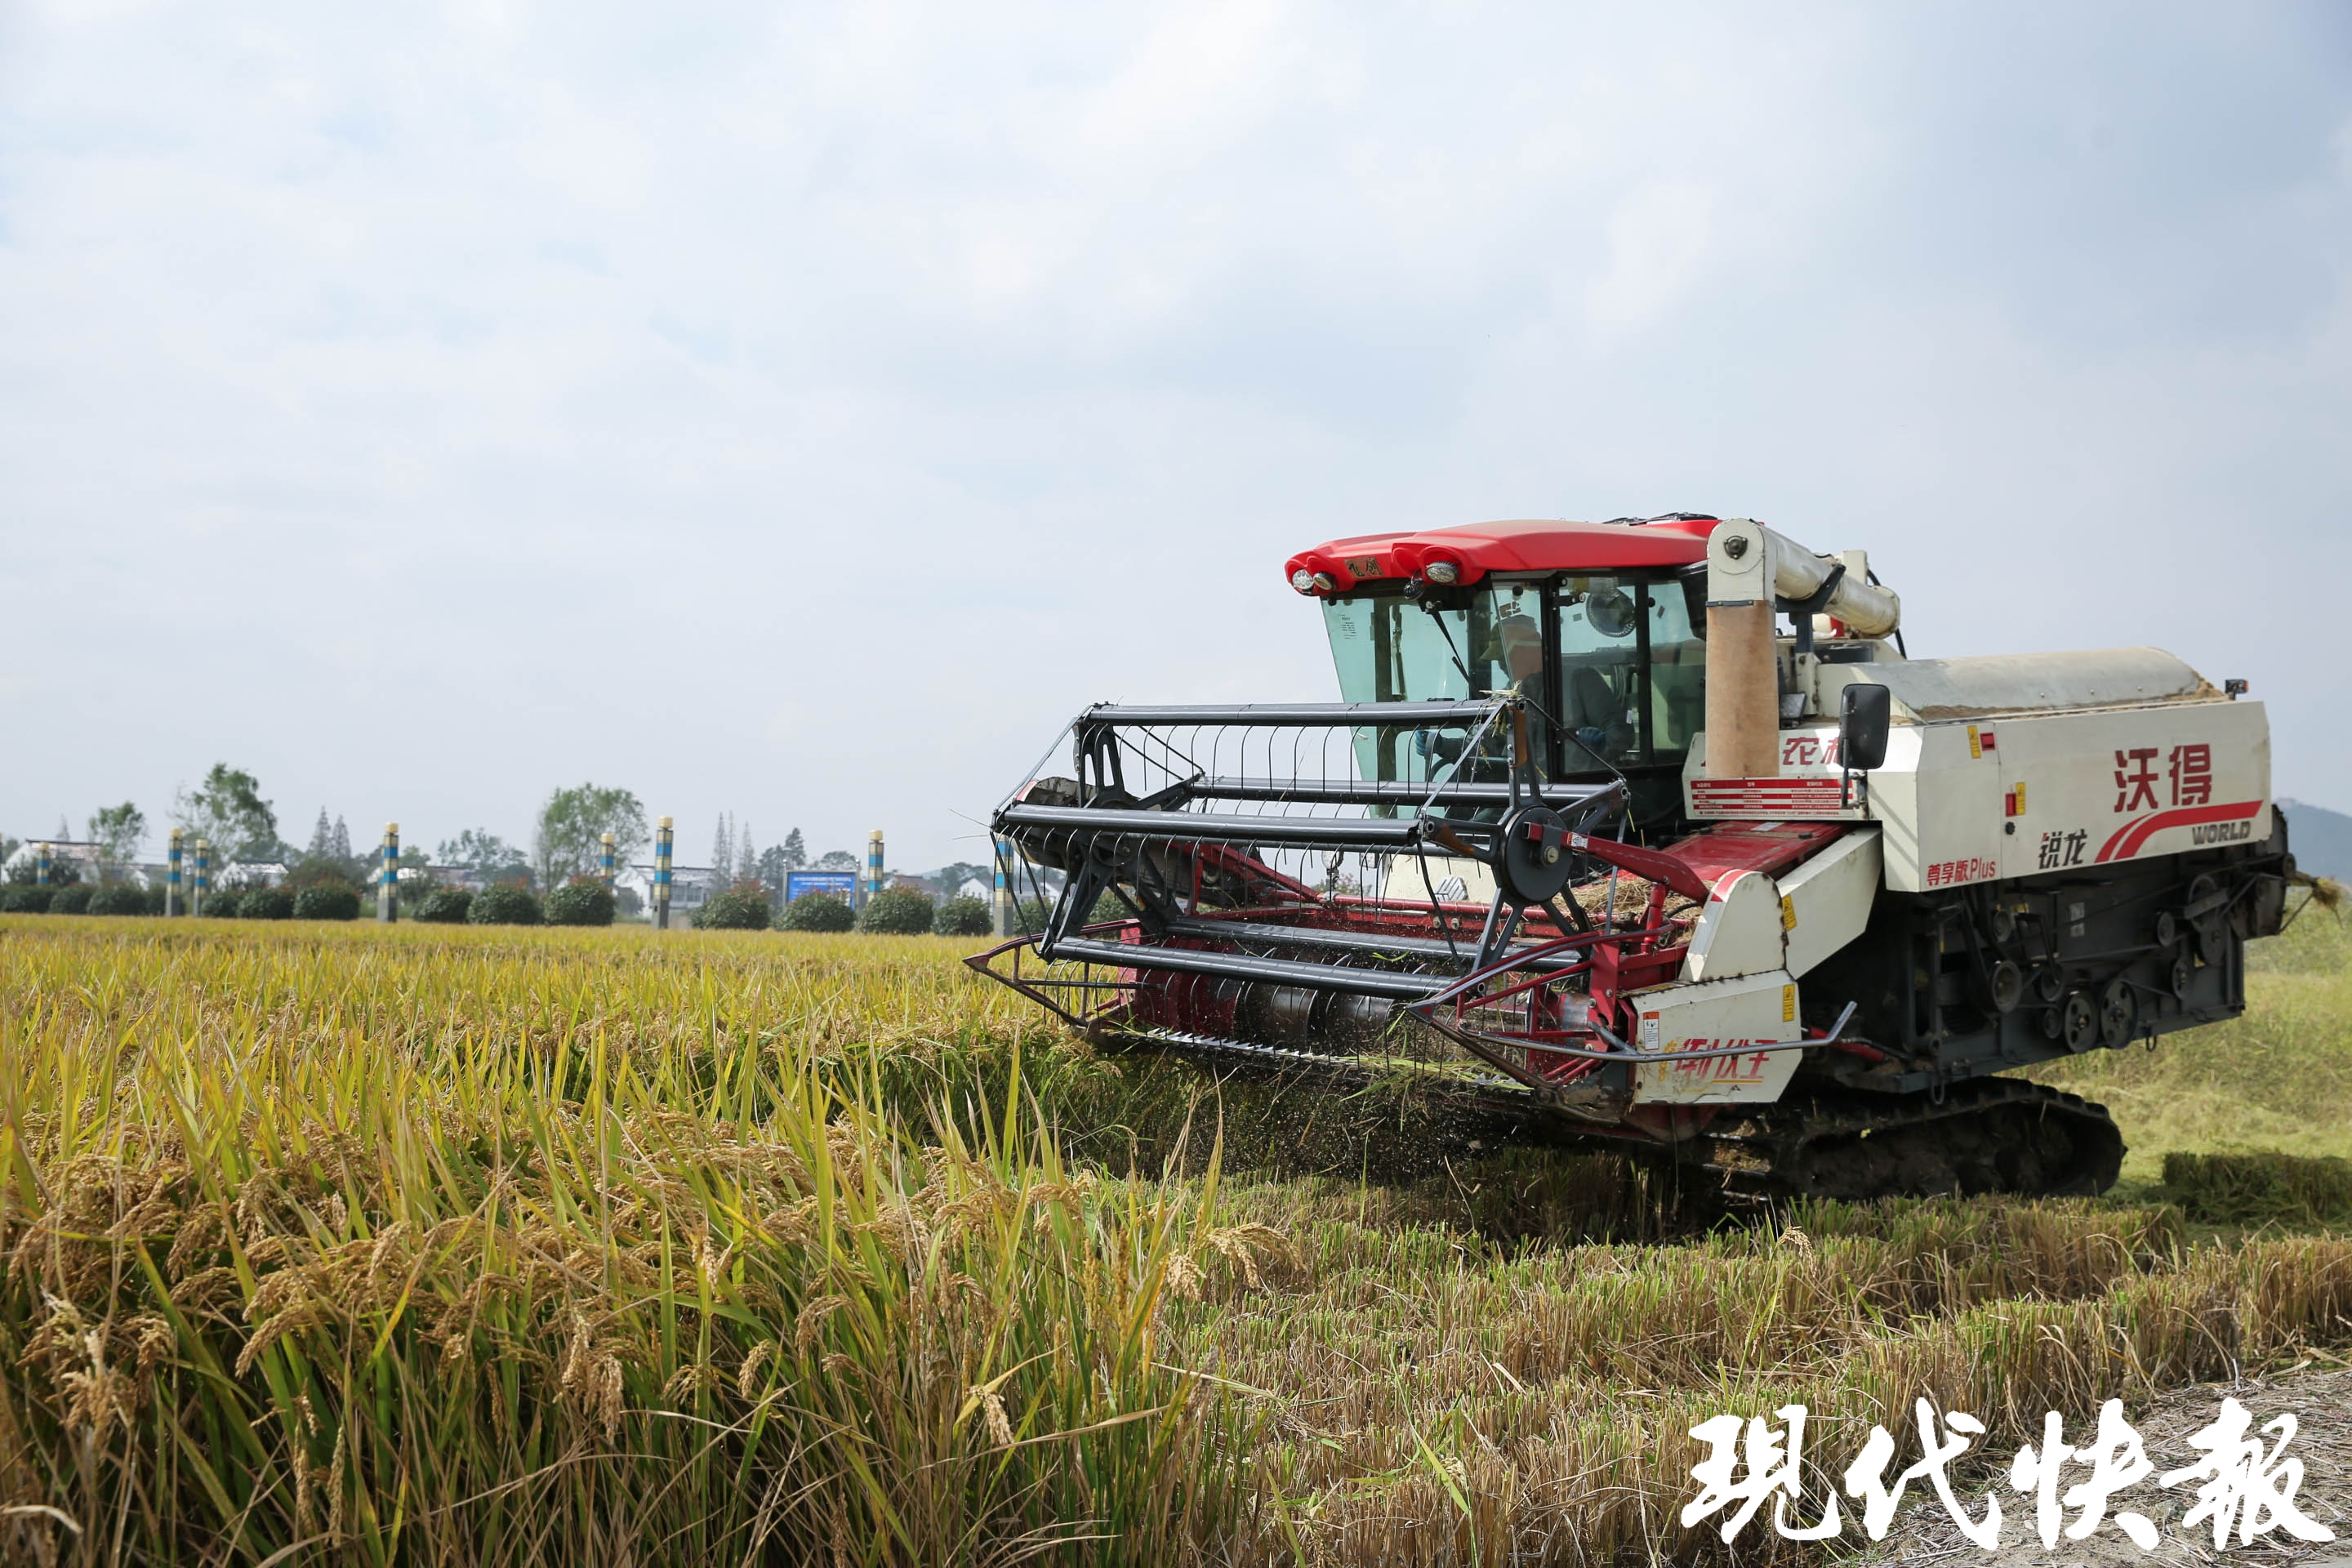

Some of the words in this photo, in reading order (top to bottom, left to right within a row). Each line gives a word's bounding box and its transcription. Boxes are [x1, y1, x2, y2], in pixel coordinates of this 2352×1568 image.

[2114, 744, 2212, 813] 沃得
[2038, 828, 2087, 870] 锐龙
[2193, 821, 2251, 845] WORLD
